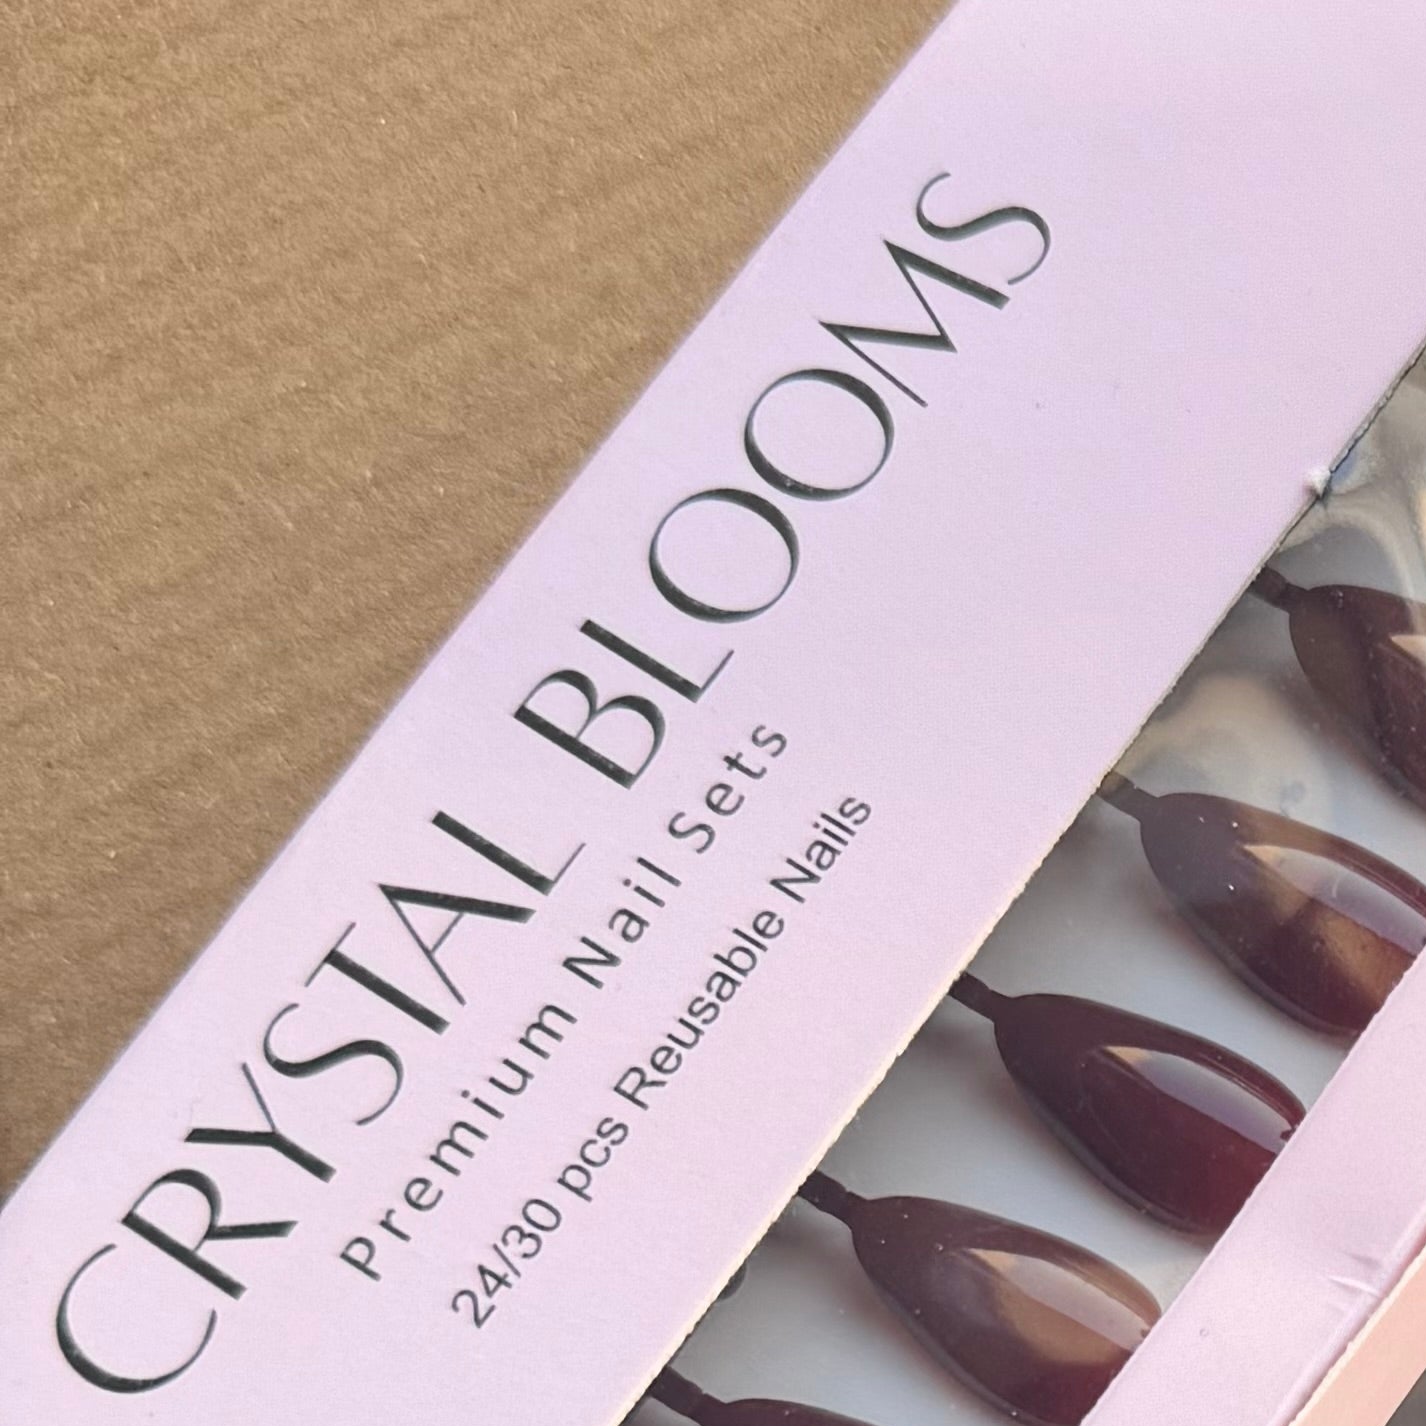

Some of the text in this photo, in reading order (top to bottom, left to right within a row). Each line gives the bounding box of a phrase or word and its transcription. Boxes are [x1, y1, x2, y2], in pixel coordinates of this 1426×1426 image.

[55, 171, 1052, 1395] CRYSTAL BLOOMS
[339, 724, 787, 1282] Premium Nail Sets
[451, 796, 872, 1328] 24/30 pcs Reusable Nails
